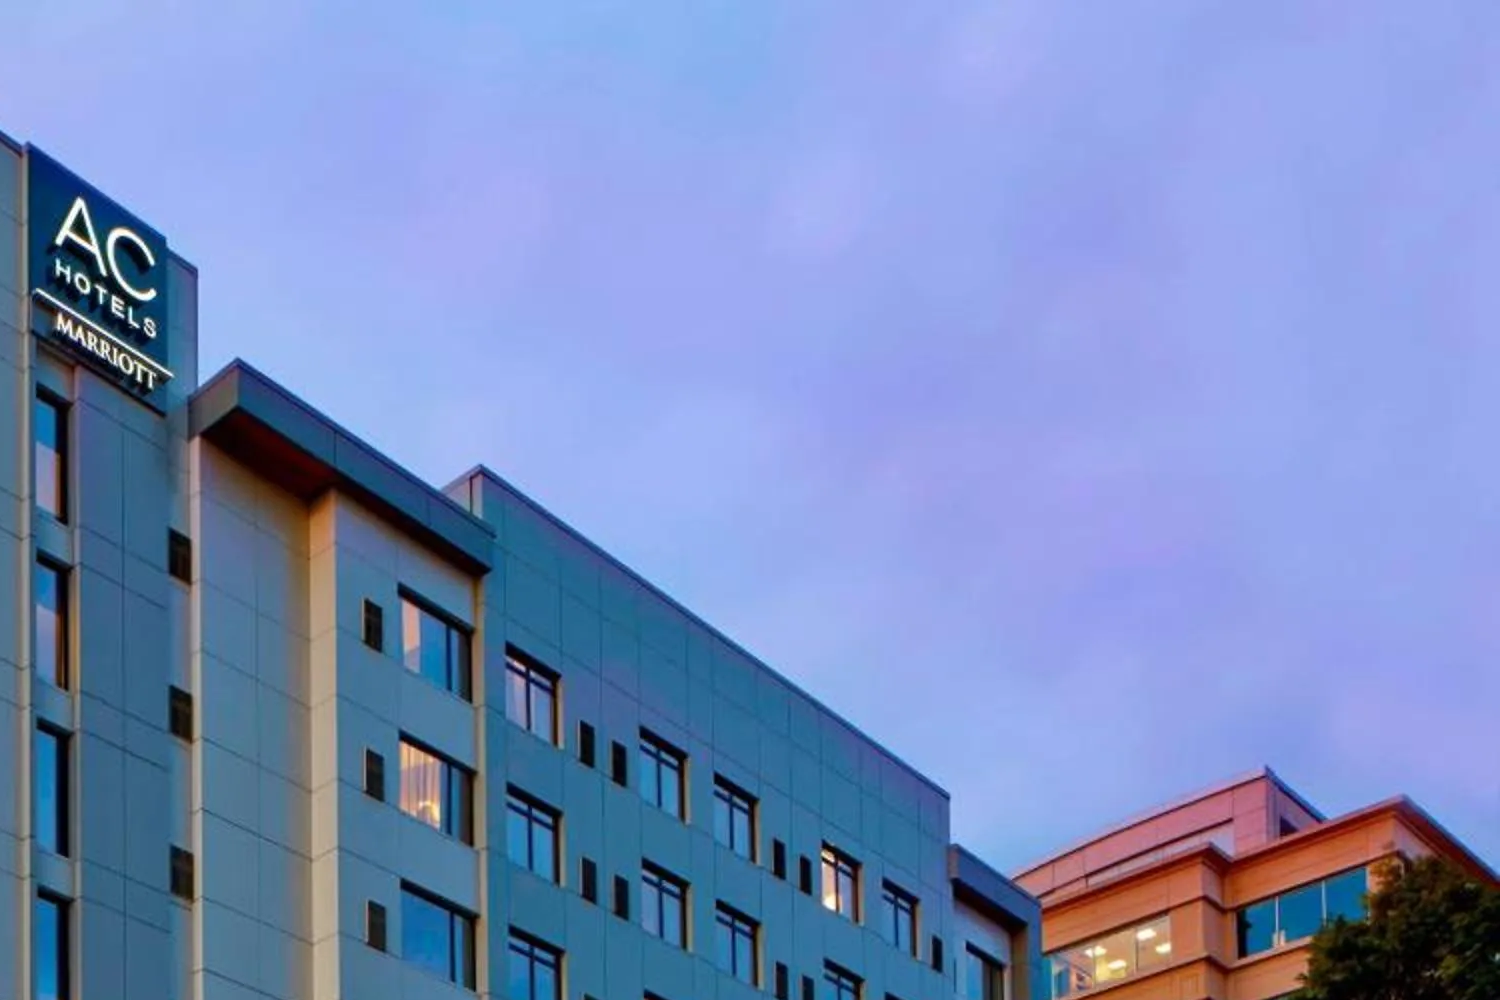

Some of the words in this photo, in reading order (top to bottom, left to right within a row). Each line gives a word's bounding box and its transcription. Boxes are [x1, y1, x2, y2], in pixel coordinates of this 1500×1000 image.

[54, 196, 157, 301] AC
[54, 258, 157, 339] HOTELS
[55, 312, 157, 390] MARRIOTT
